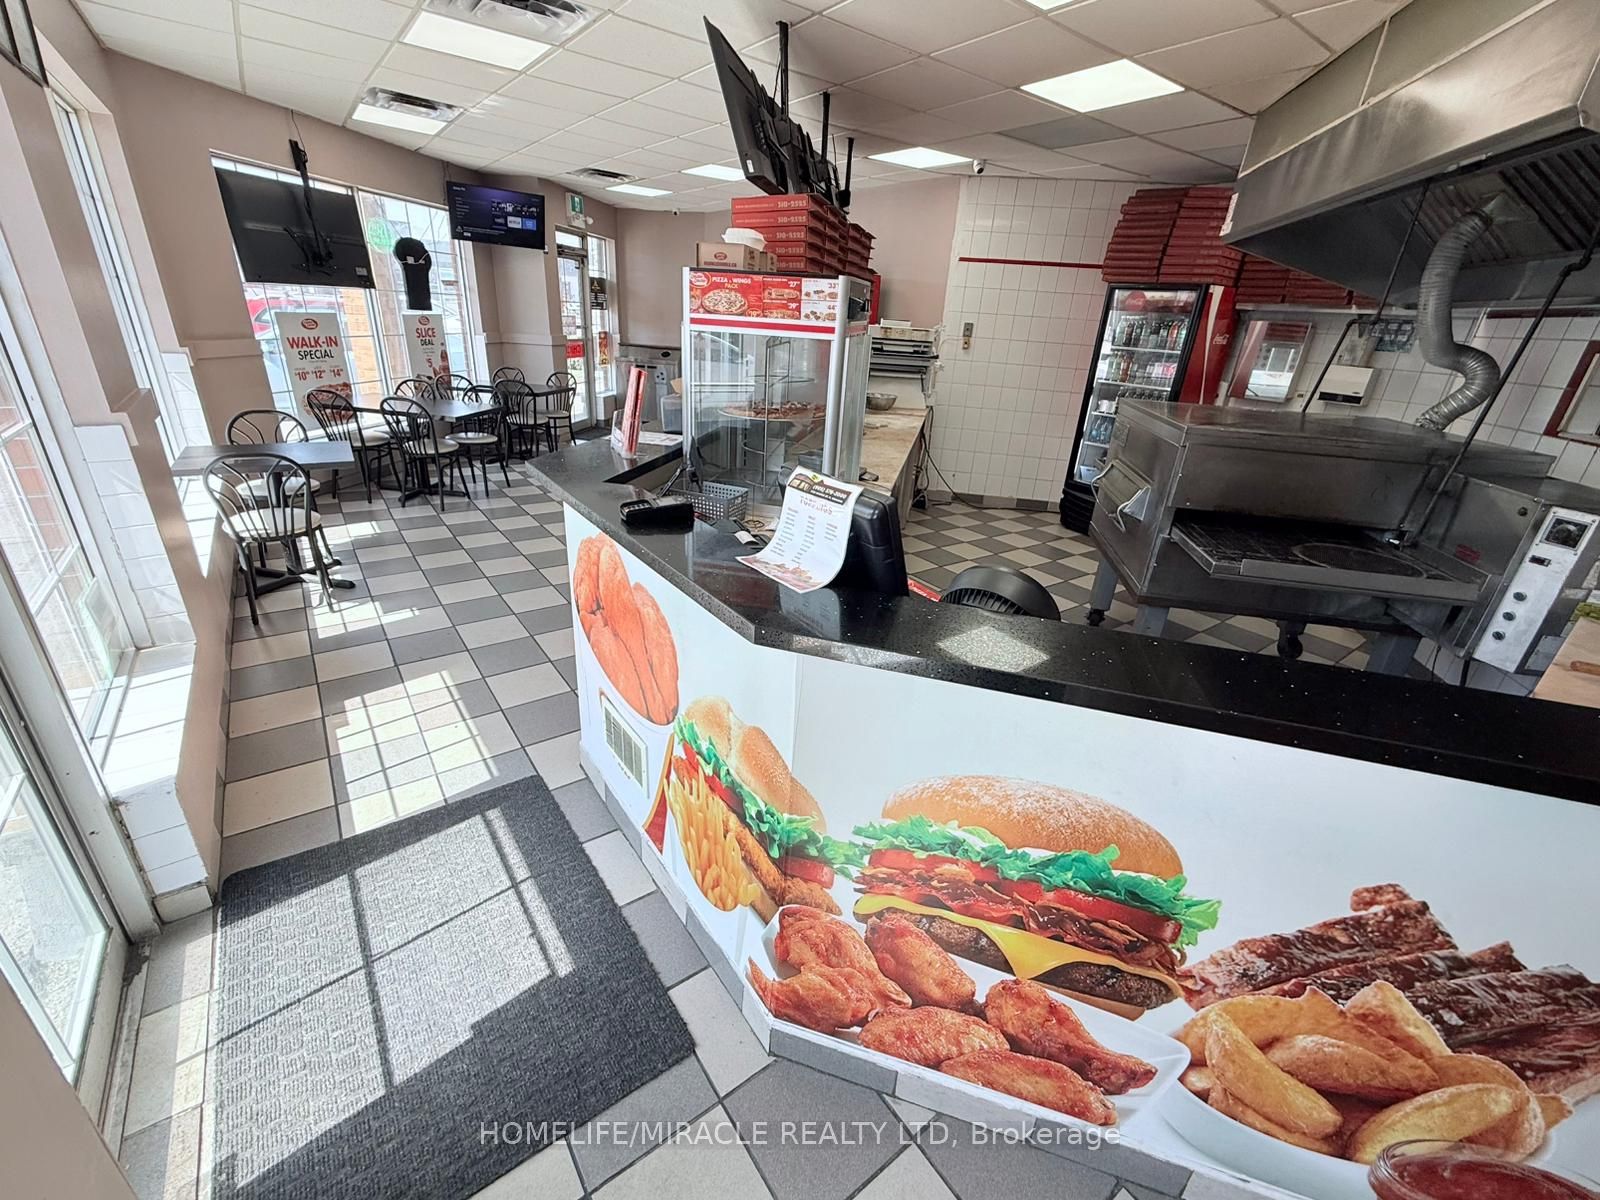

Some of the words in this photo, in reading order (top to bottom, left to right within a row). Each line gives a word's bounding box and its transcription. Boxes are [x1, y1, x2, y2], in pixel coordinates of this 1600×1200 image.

[415, 327, 437, 339] SLICE
[286, 335, 339, 349] WALK-IN
[420, 338, 435, 346] DEAL
[297, 349, 335, 361] SPECIAL
